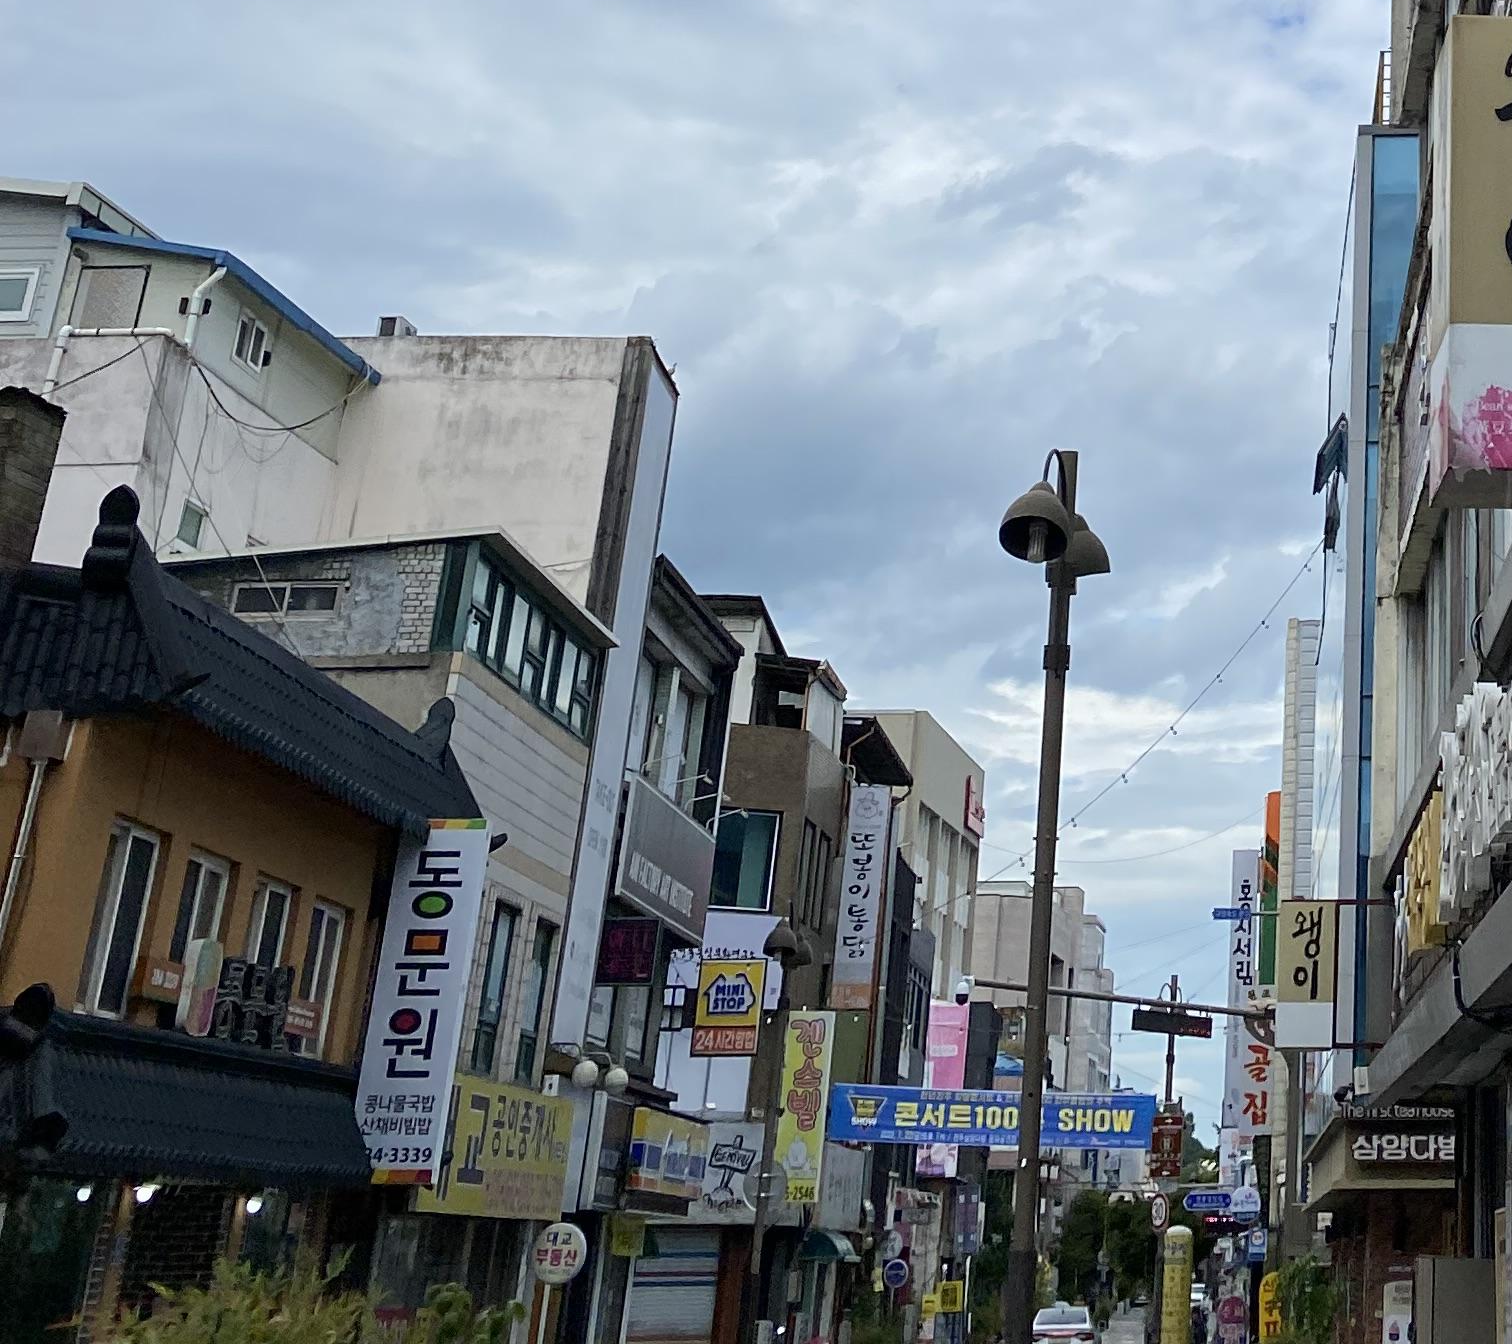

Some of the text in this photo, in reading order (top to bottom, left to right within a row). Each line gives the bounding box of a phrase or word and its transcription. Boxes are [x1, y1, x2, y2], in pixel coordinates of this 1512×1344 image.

[1292, 906, 1324, 1001] 왱이
[383, 850, 463, 1079] 동문원
[715, 982, 745, 997] MINI
[712, 997, 746, 1011] STOP
[364, 1094, 436, 1114] 콩나물국밥
[360, 1116, 433, 1136] 산채비빔밥
[894, 1101, 1043, 1131] 콘서트100
[1057, 1107, 1136, 1133] SHOW
[546, 1230, 572, 1246] 대교
[535, 1248, 578, 1268] 부동산
